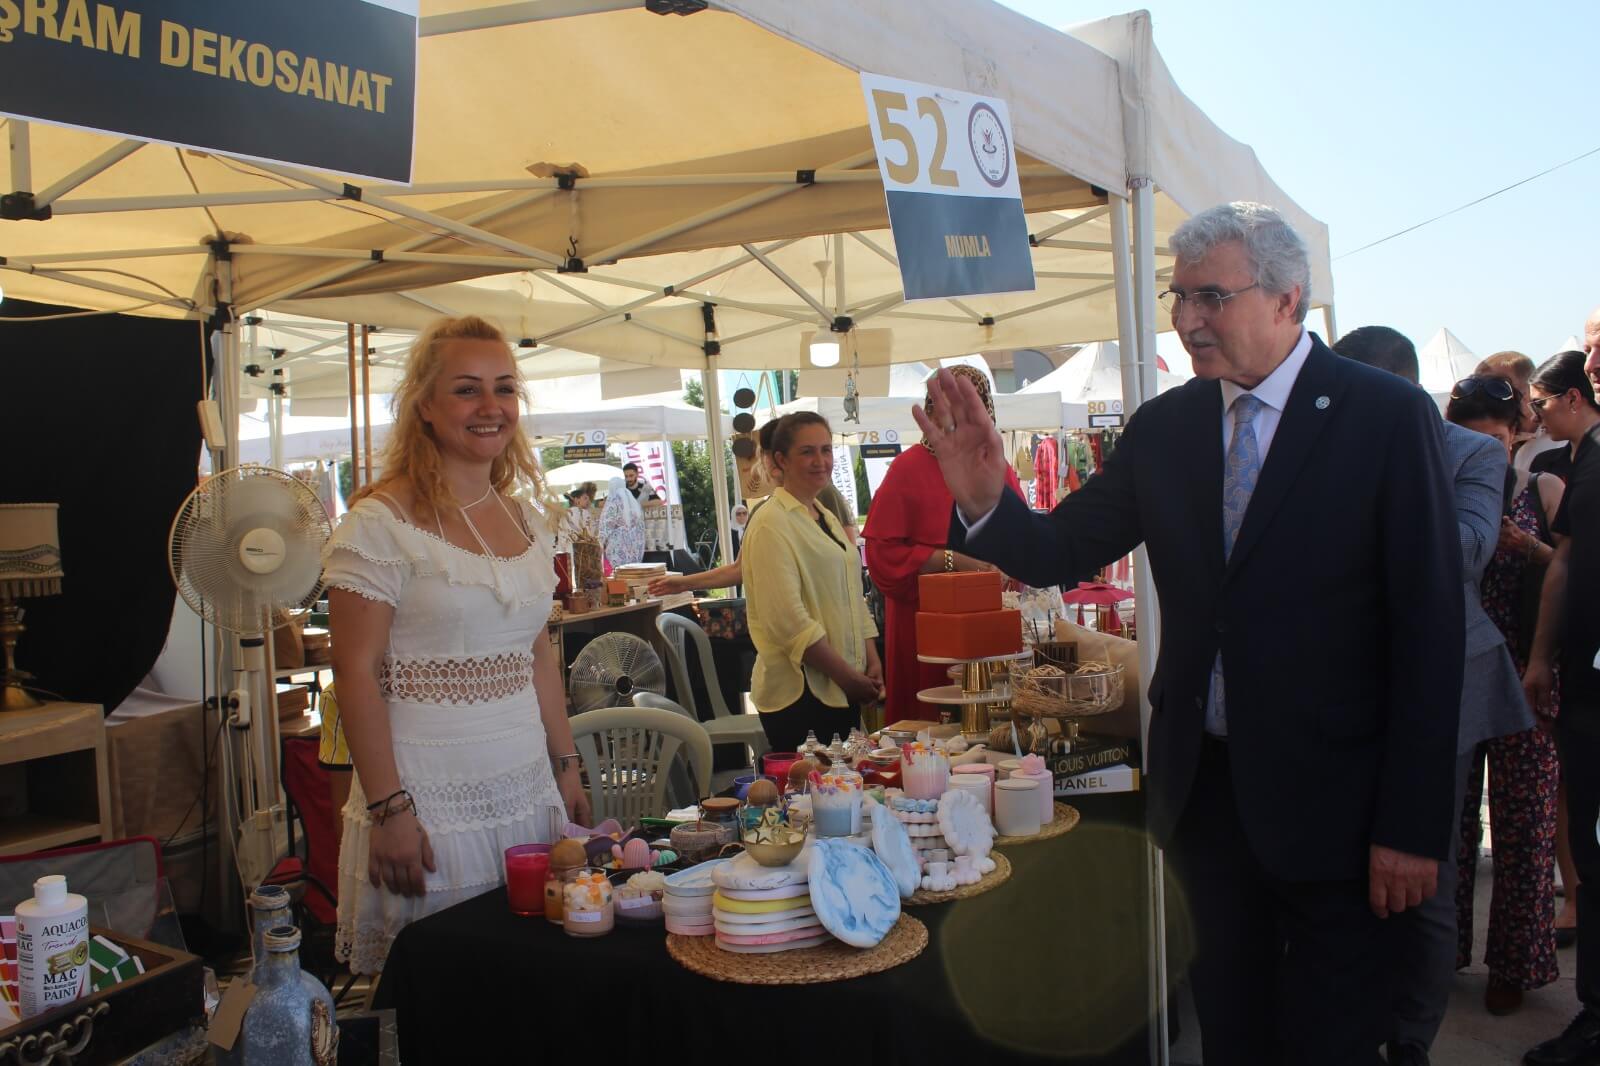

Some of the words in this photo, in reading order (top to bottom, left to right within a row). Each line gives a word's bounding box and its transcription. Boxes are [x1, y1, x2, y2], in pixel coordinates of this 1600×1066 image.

[161, 20, 392, 114] DEKOSANAT
[872, 89, 959, 187] 52
[944, 235, 992, 257] MUMLA
[1088, 401, 1106, 414] 80
[565, 432, 585, 445] 76
[860, 431, 880, 443] 78
[1054, 758, 1085, 774] LOUIS
[1087, 747, 1129, 766] VUITTON
[1053, 777, 1107, 790] HANEL
[41, 916, 88, 936] AQUACO
[43, 968, 77, 984] MAC
[44, 986, 78, 1001] PAINT
